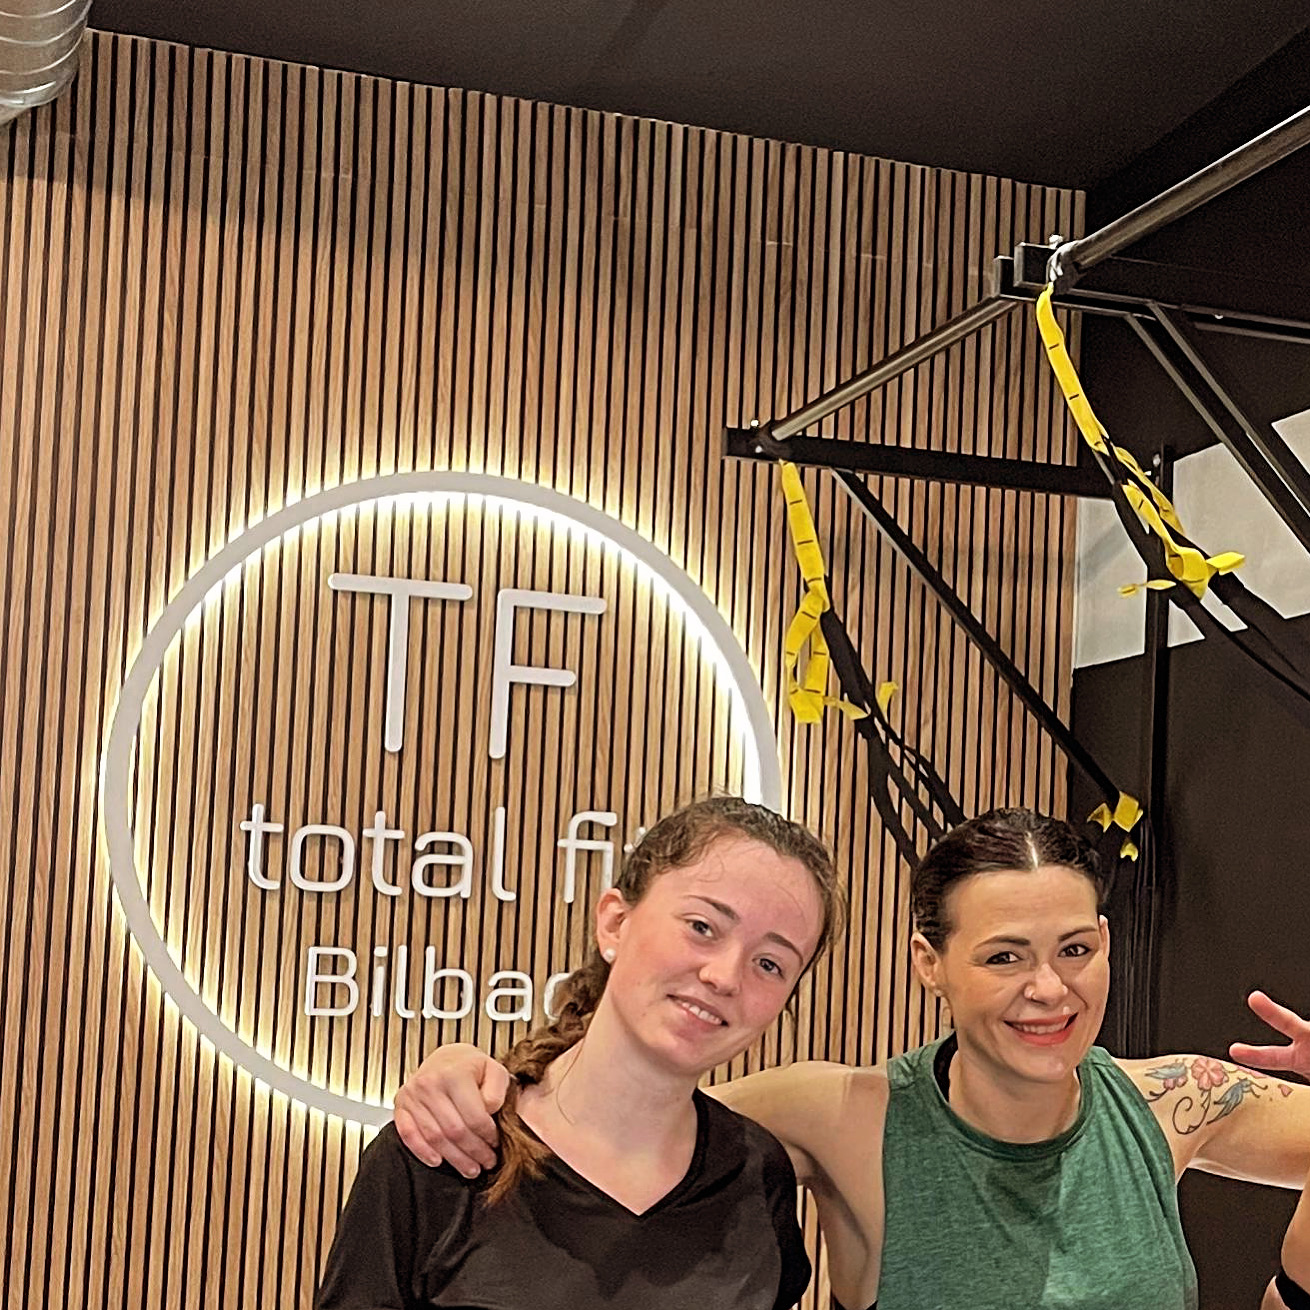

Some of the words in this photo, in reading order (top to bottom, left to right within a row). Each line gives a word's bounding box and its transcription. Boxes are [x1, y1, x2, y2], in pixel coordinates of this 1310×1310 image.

[327, 572, 607, 759] TF
[239, 802, 517, 902] total
[557, 810, 648, 904] fi
